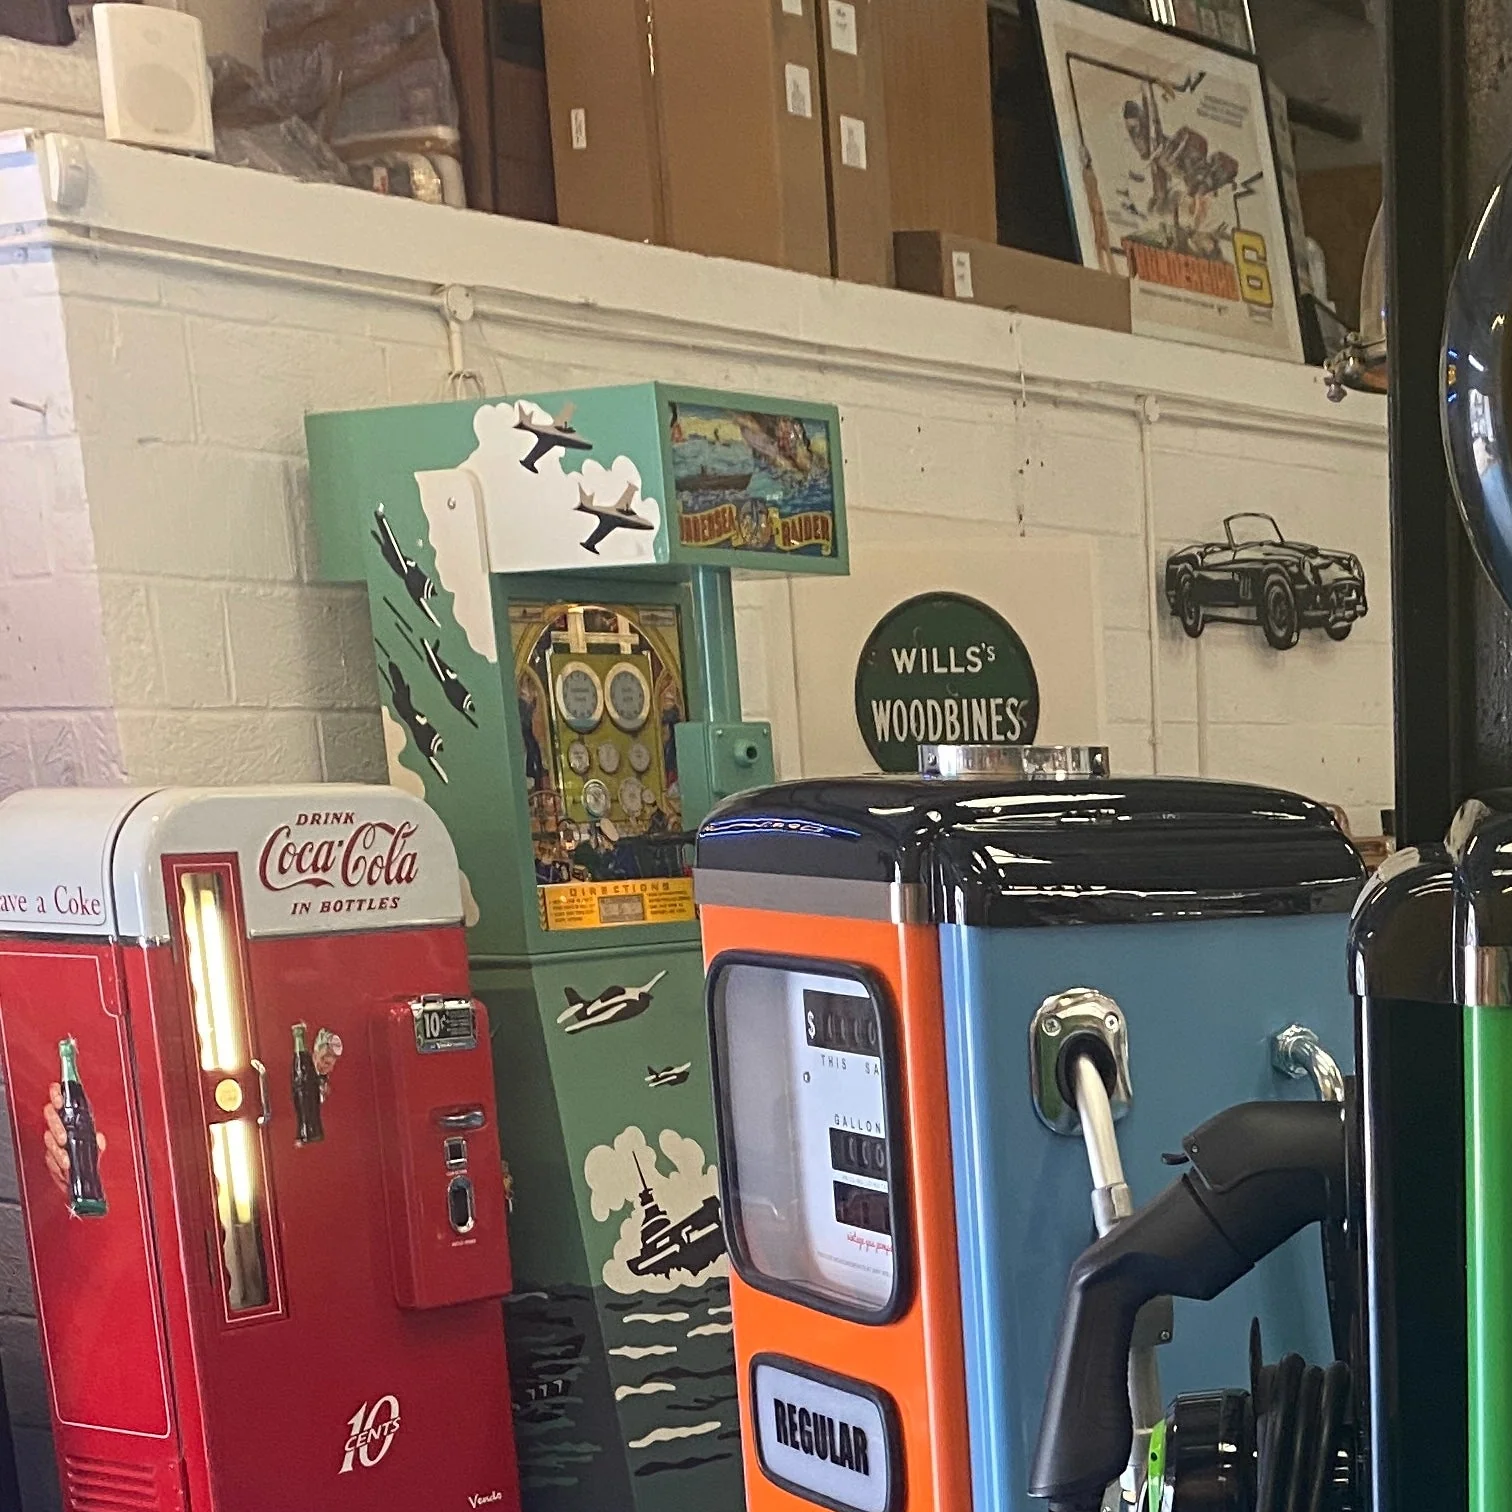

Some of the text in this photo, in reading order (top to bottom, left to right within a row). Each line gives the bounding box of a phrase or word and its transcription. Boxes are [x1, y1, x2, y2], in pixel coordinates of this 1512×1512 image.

[1232, 227, 1273, 307] 6
[871, 696, 1022, 743] WOODBINES
[295, 811, 356, 826] DRINK
[258, 821, 420, 892] Coca-Cola
[0, 885, 101, 916] ave a Coke
[569, 882, 670, 897] DIRECTIONS
[290, 897, 401, 915] IN BOTTLES
[820, 1054, 880, 1076] THIS SA
[834, 1113, 882, 1135] GALLON
[338, 1395, 400, 1475] 10
[344, 1416, 401, 1452] CENTS
[774, 1398, 870, 1477] REGULAR
[468, 1490, 503, 1509] Vendo
